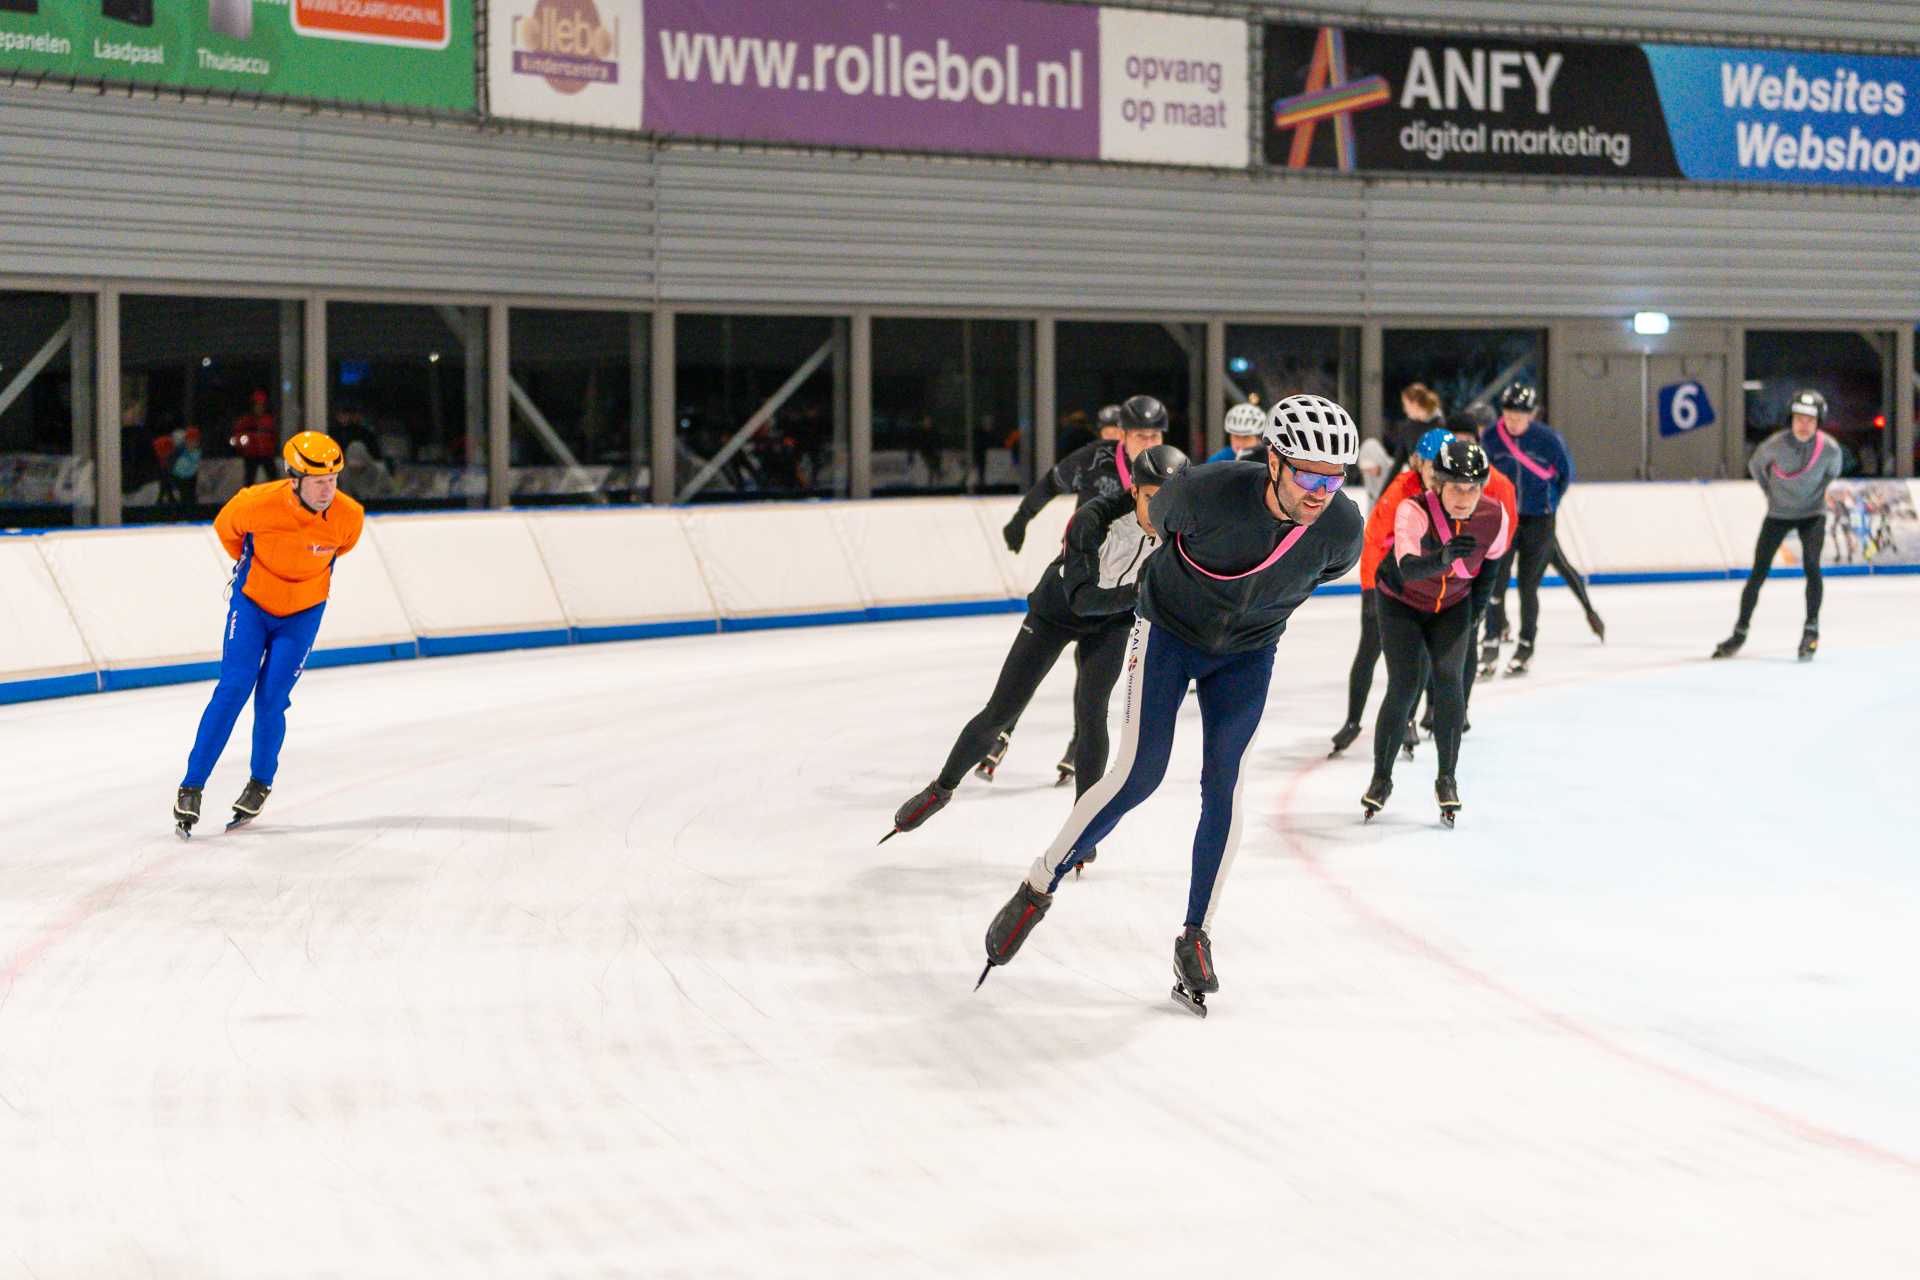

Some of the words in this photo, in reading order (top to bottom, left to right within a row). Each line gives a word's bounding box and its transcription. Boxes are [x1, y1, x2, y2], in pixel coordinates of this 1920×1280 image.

[93, 38, 164, 65] Laadpaal
[198, 48, 270, 75] Thuisaccu
[659, 30, 1083, 109] www.rollebol.nl
[1125, 54, 1223, 91] opvang
[1400, 48, 1563, 113] ANFY
[1722, 63, 1906, 116] Websites
[1121, 98, 1155, 130] op
[1163, 100, 1227, 130] maat
[1401, 122, 1486, 158] digital
[1493, 126, 1630, 166] marketing
[1735, 121, 1920, 182] Webshop
[1672, 385, 1699, 430] 6
